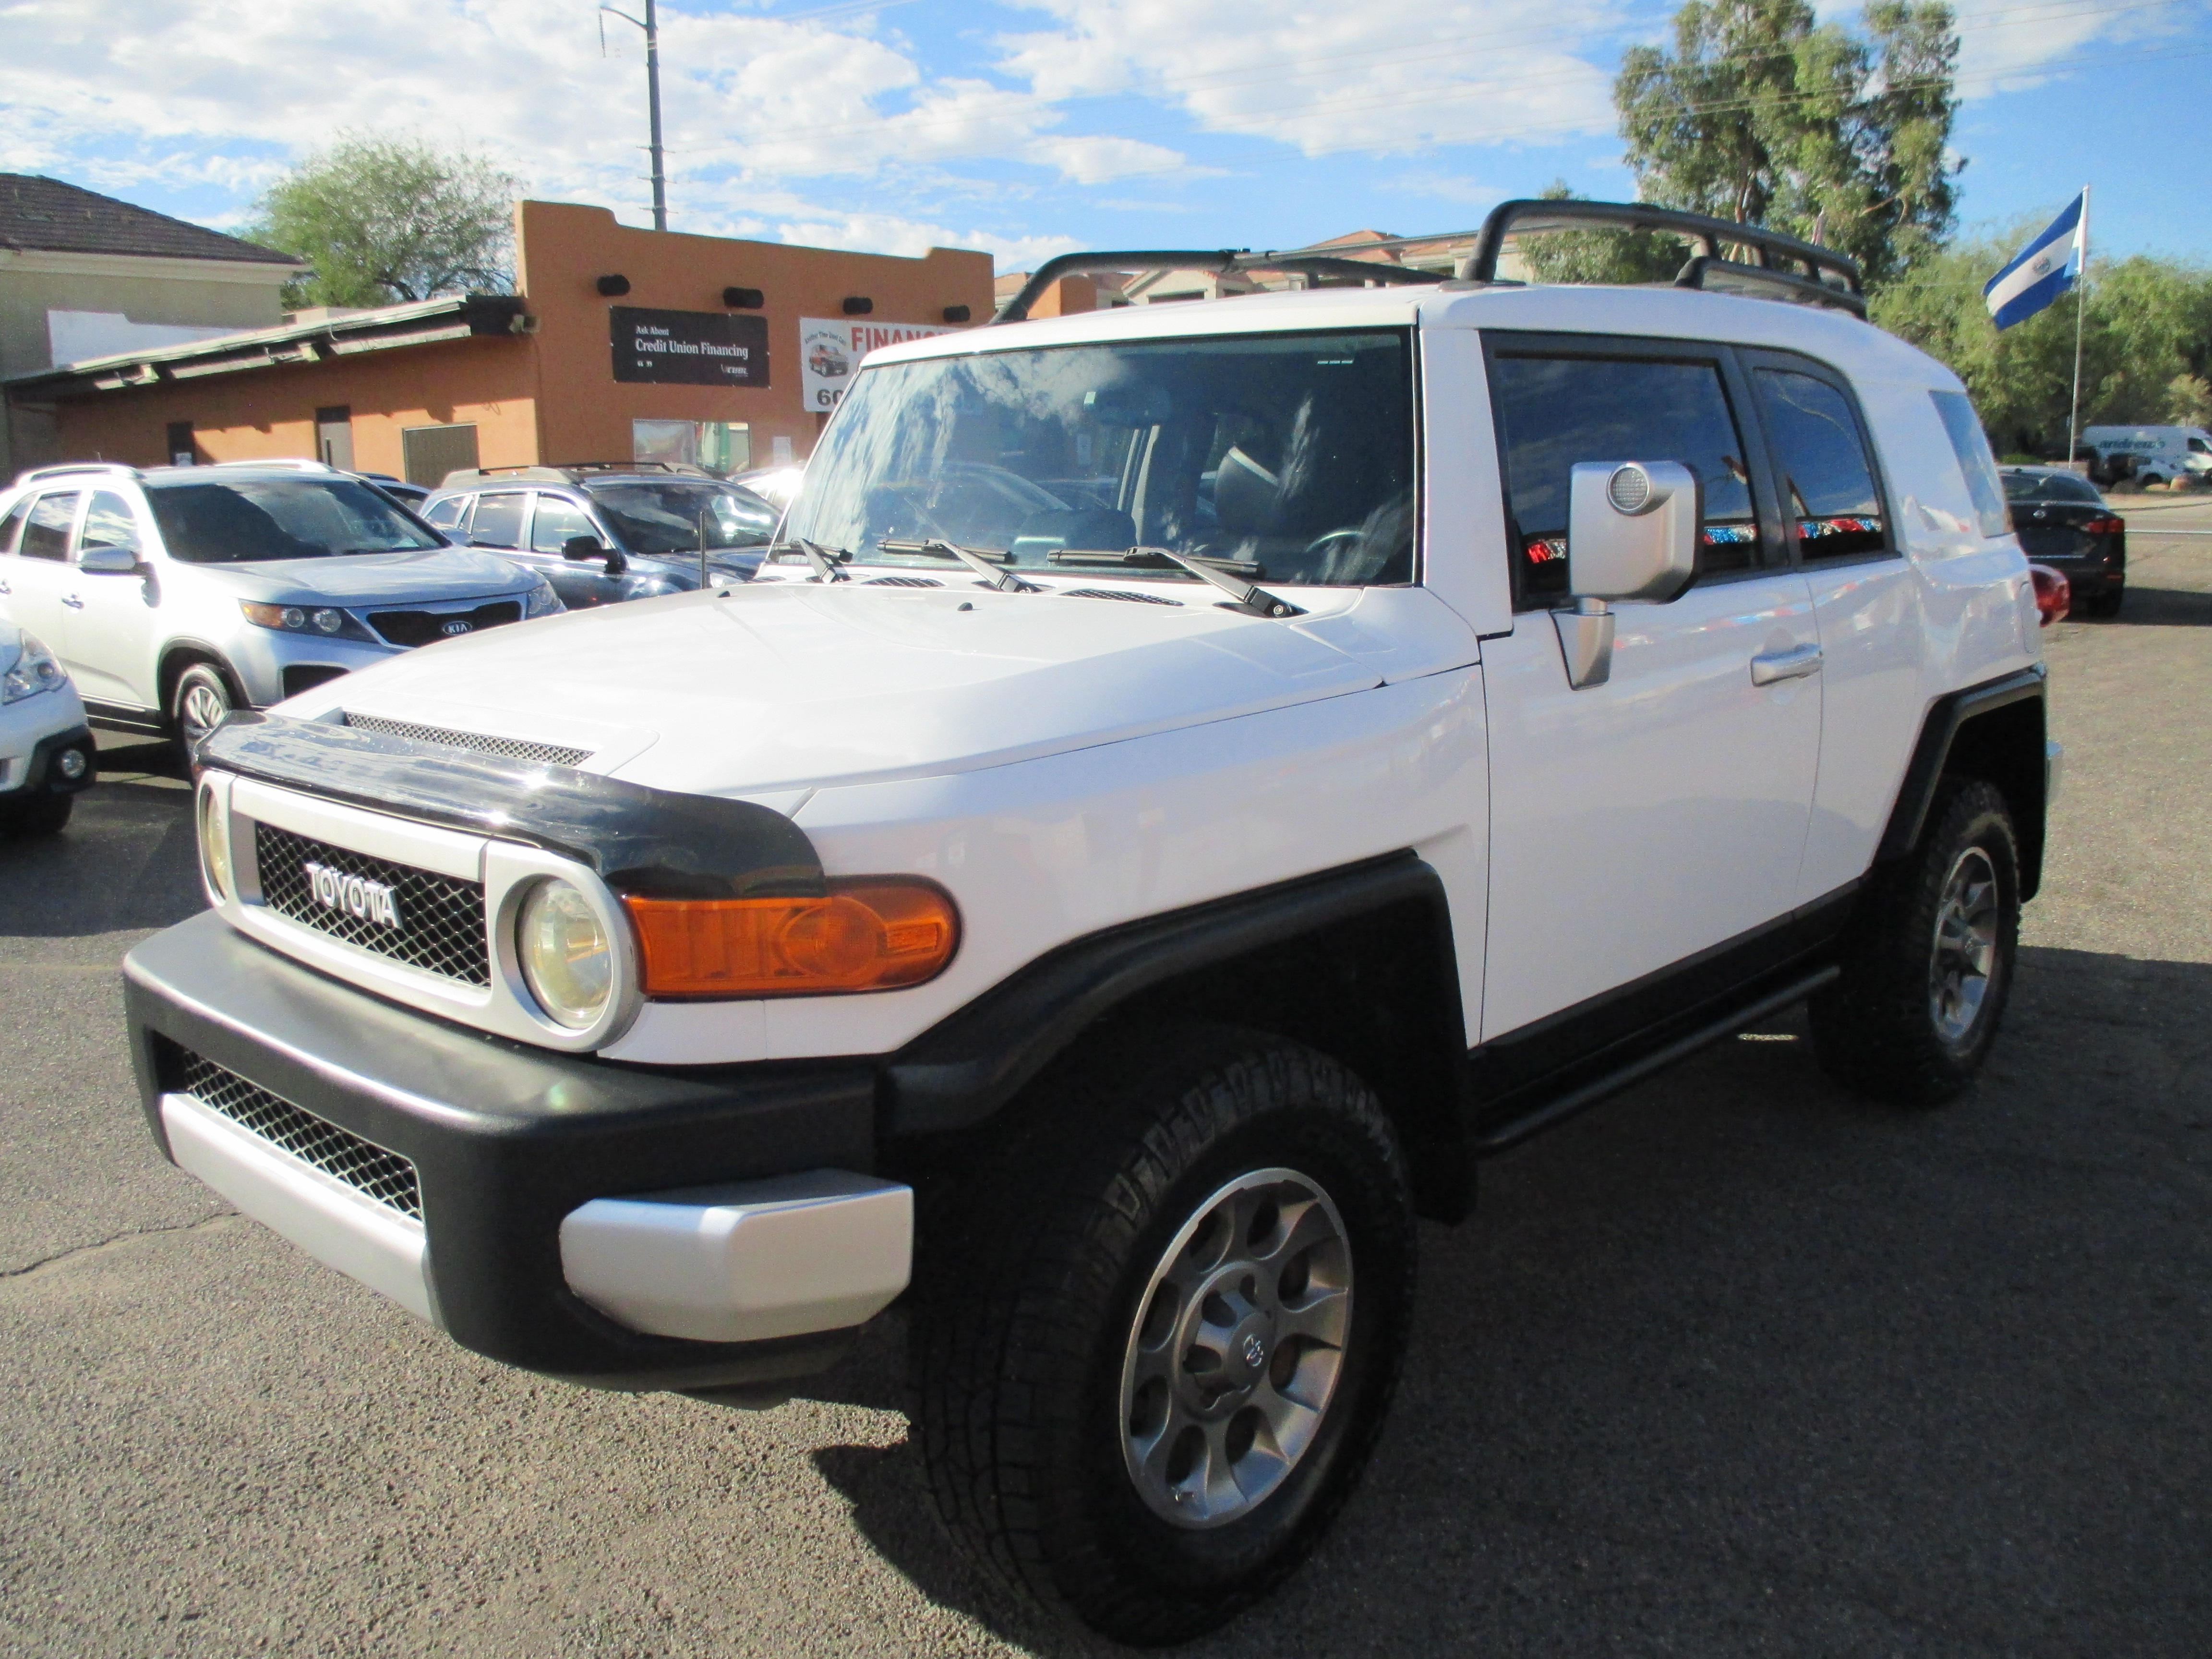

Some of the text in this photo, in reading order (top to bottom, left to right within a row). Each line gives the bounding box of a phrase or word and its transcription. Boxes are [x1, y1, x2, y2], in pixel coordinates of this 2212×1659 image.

[636, 325, 669, 336] Ask About
[635, 338, 748, 360] Credit Union Financing
[448, 624, 468, 633] KIA
[305, 863, 402, 928] TOYOTA
